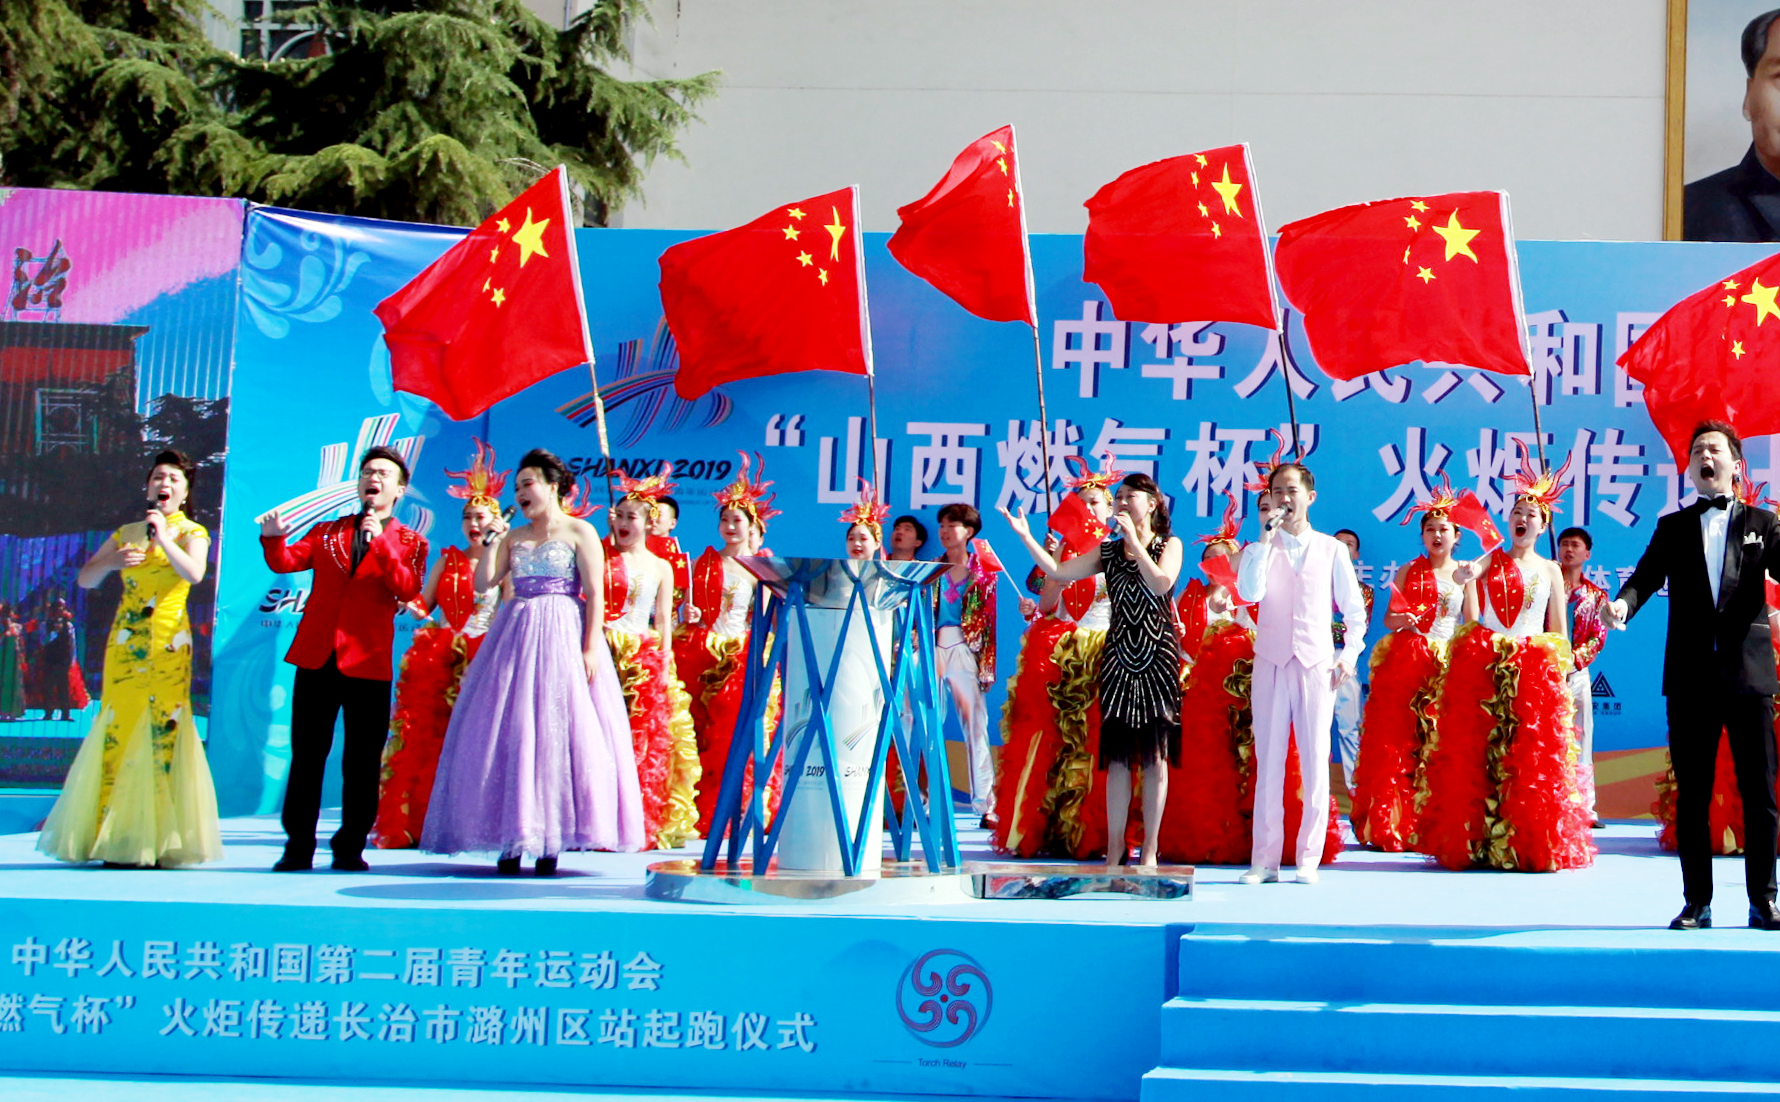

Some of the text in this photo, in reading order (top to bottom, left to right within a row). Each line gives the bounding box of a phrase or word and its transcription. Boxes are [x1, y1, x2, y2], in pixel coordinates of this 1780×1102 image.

[671, 459, 732, 480] 2019
[806, 765, 825, 777] 2019
[11, 936, 665, 991] 中华人民共和国第二届青年运动会
[159, 997, 818, 1053] 火炬传递长治市潞州区站起跑仪式
[918, 1058, 967, 1070] Torch Relay
